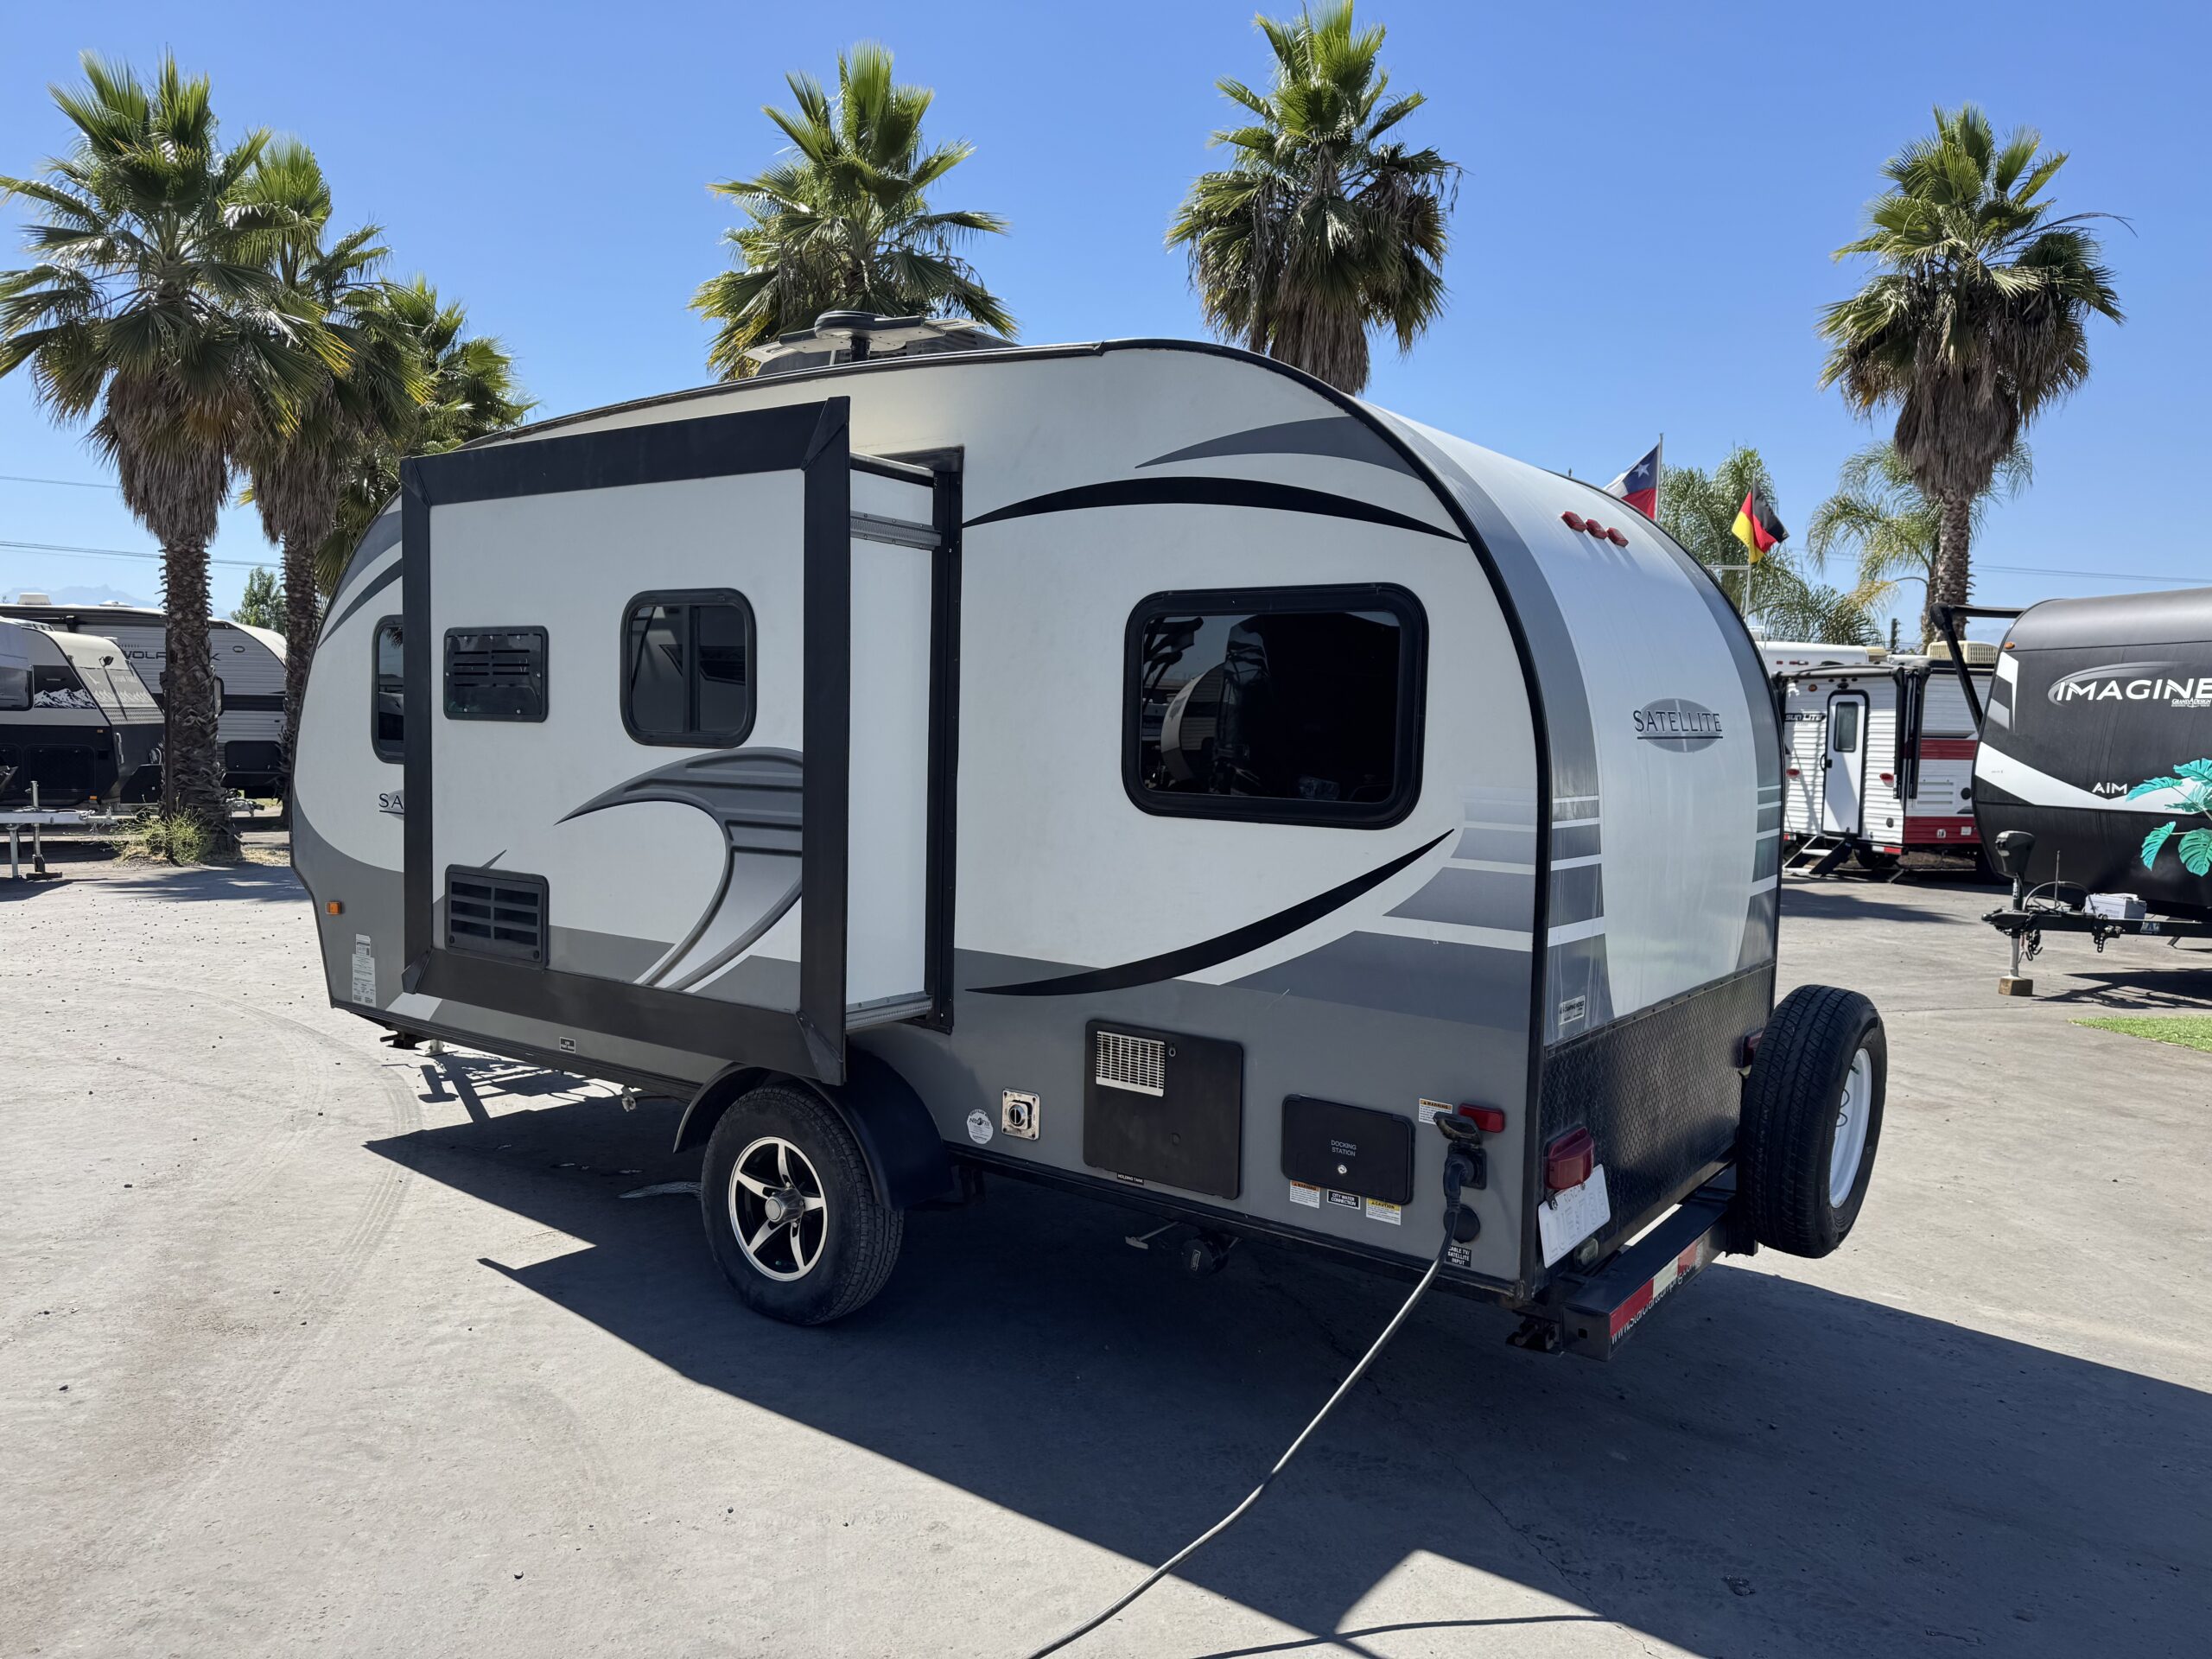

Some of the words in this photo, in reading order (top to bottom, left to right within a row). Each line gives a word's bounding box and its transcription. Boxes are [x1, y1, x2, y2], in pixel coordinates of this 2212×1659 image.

[2056, 678, 2212, 701] IMAGINE
[1632, 709, 1722, 732] SATELLITE
[1331, 1140, 1357, 1150] DOCKING
[1332, 1147, 1356, 1157] STATION
[1331, 1197, 1357, 1207] CONNECTION
[1375, 1200, 1395, 1210] CAUTION
[1447, 1250, 1470, 1262] SATELLITE
[1452, 1257, 1465, 1266] INPUT
